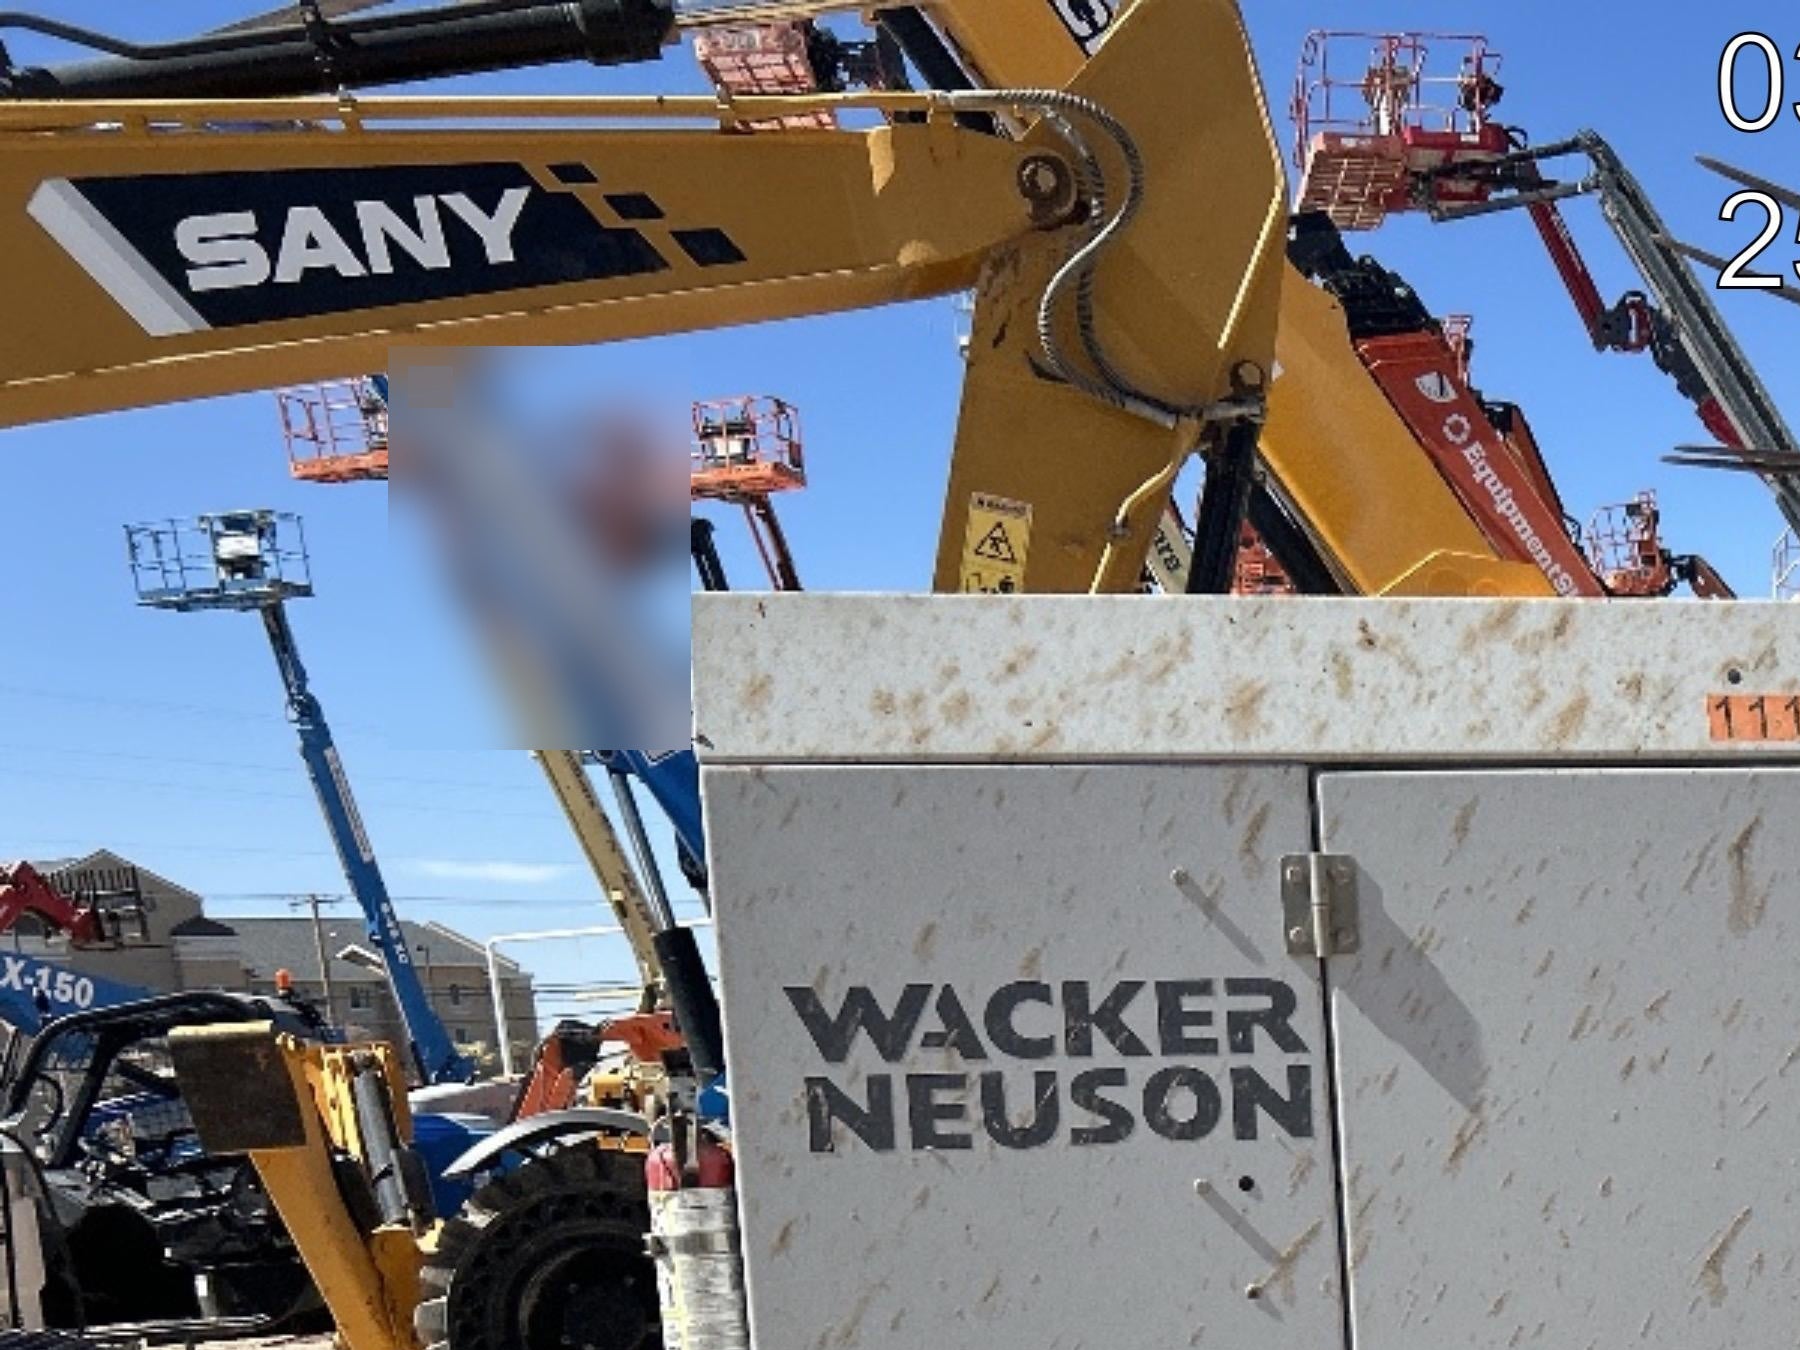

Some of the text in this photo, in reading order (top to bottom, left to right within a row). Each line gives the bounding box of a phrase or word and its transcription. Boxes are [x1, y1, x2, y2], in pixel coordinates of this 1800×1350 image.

[173, 187, 532, 293] SANY
[783, 977, 1310, 1063] WACKER
[805, 1065, 1313, 1153] NEUSON
